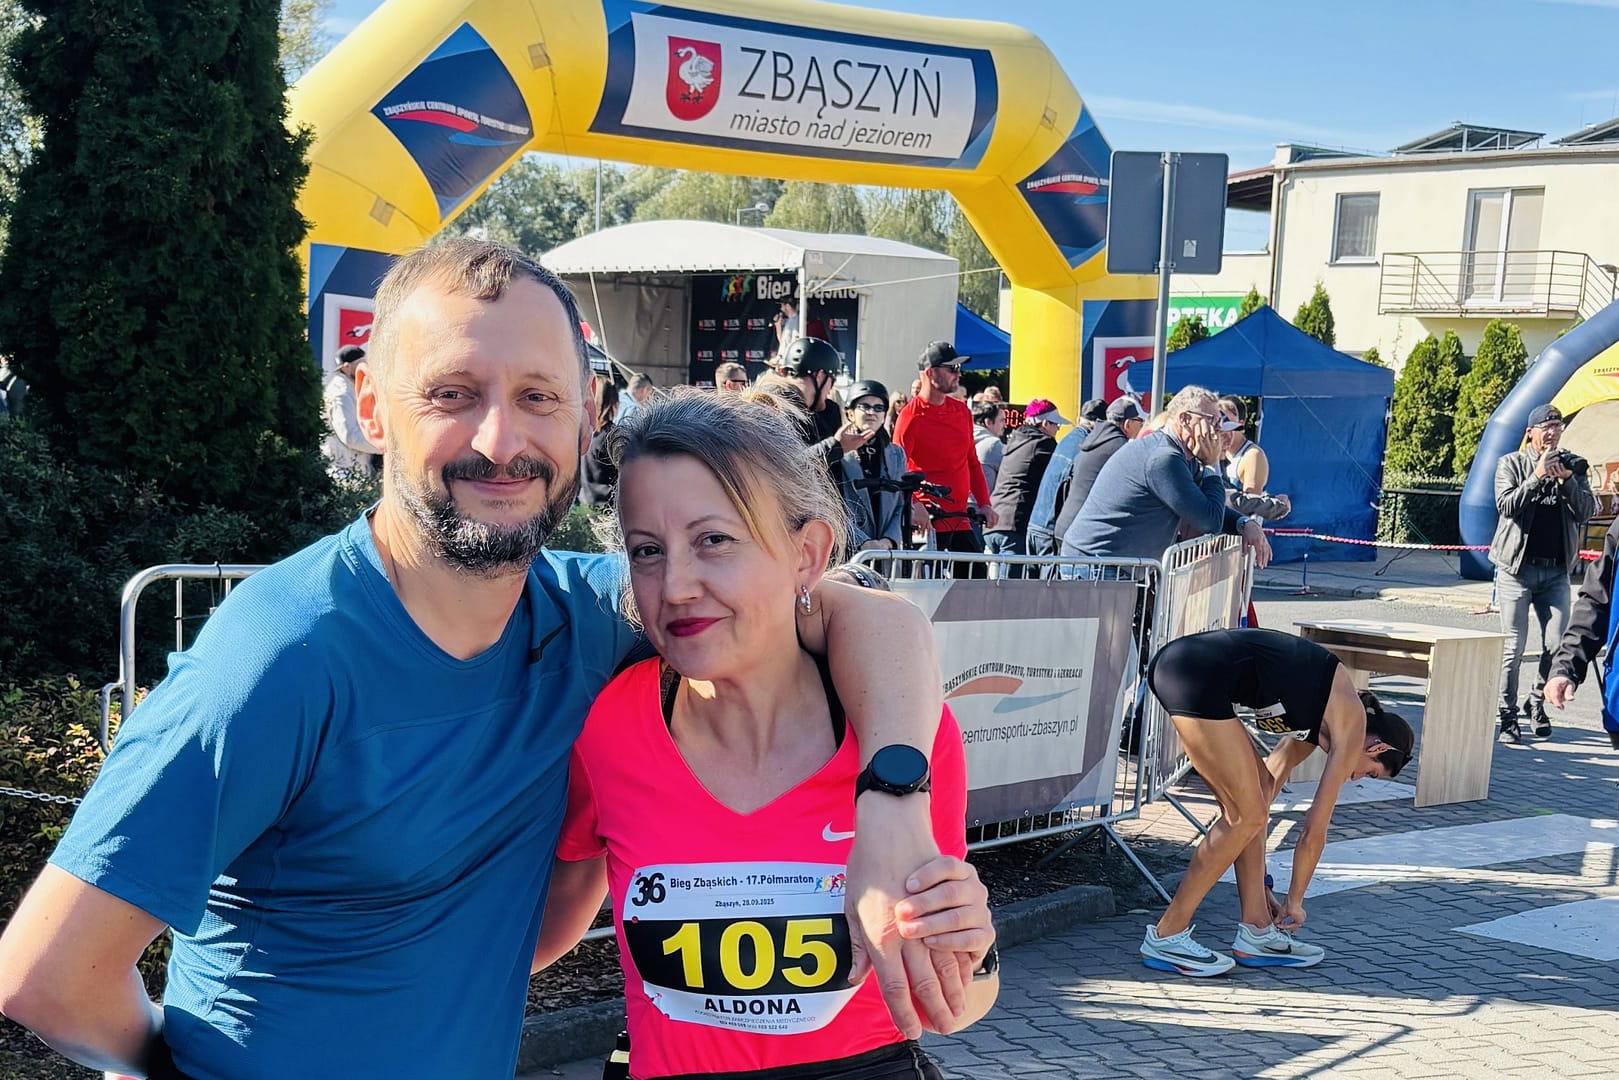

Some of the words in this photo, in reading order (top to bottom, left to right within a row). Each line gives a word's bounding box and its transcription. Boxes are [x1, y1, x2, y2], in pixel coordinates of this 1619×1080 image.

[737, 46, 941, 119] ZBĄSZYŃ
[729, 109, 800, 136] miasto
[805, 118, 846, 141] nad
[843, 120, 932, 149] jeziorem
[1166, 307, 1238, 327] PTEKA
[943, 666, 977, 693] BĄSZYŃSKIE
[979, 662, 1004, 674] CENTRUM
[632, 872, 666, 906] 36
[670, 878, 691, 890] Bieg
[693, 876, 738, 889] Zbąskich
[662, 918, 838, 990] 105
[704, 998, 802, 1015] ALDONA
